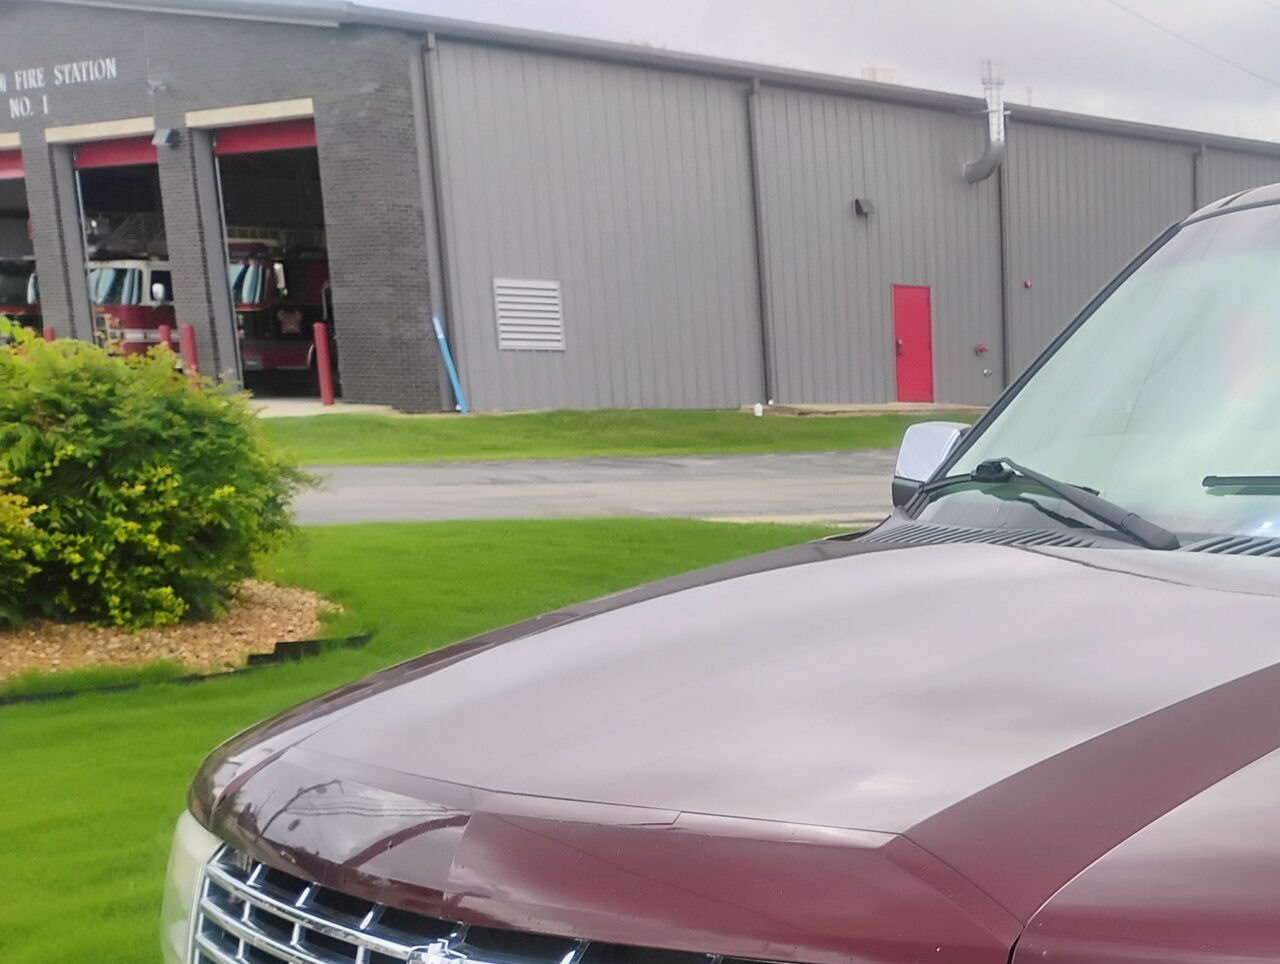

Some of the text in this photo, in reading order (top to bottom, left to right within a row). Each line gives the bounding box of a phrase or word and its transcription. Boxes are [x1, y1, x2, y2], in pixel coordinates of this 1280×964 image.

[14, 67, 45, 91] FIRE
[53, 57, 117, 85] STATION
[9, 97, 34, 118] NO.
